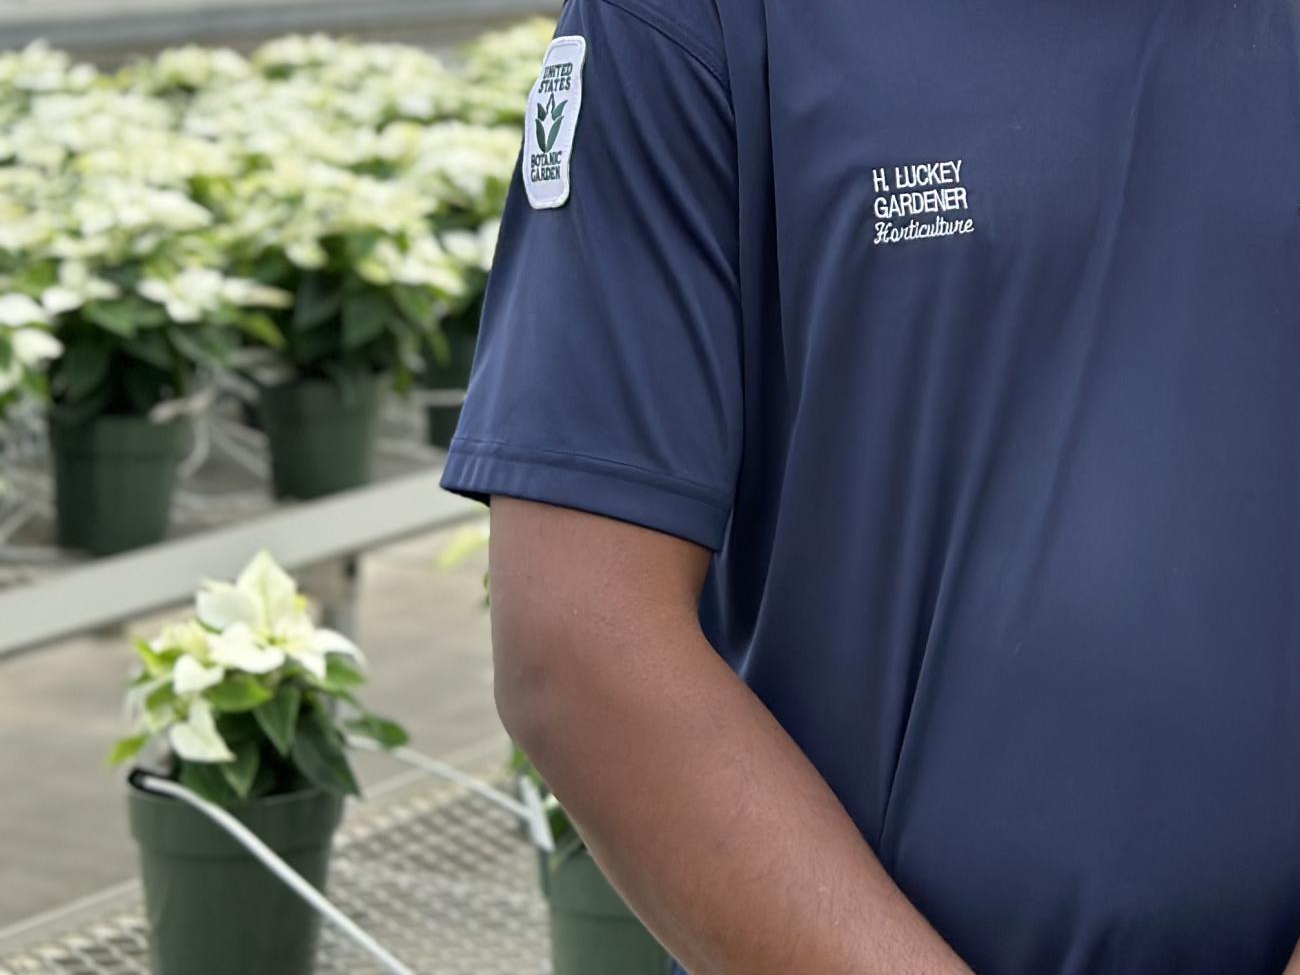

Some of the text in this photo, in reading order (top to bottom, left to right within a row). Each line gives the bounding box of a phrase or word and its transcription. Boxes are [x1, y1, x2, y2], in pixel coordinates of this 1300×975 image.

[543, 62, 573, 79] UNITED
[538, 76, 571, 94] STATES
[530, 151, 562, 168] BOTANIC
[530, 166, 561, 182] GARDEN
[895, 159, 962, 189] LUCKEY
[874, 187, 968, 218] GARDENER
[873, 215, 975, 244] Horticulture
